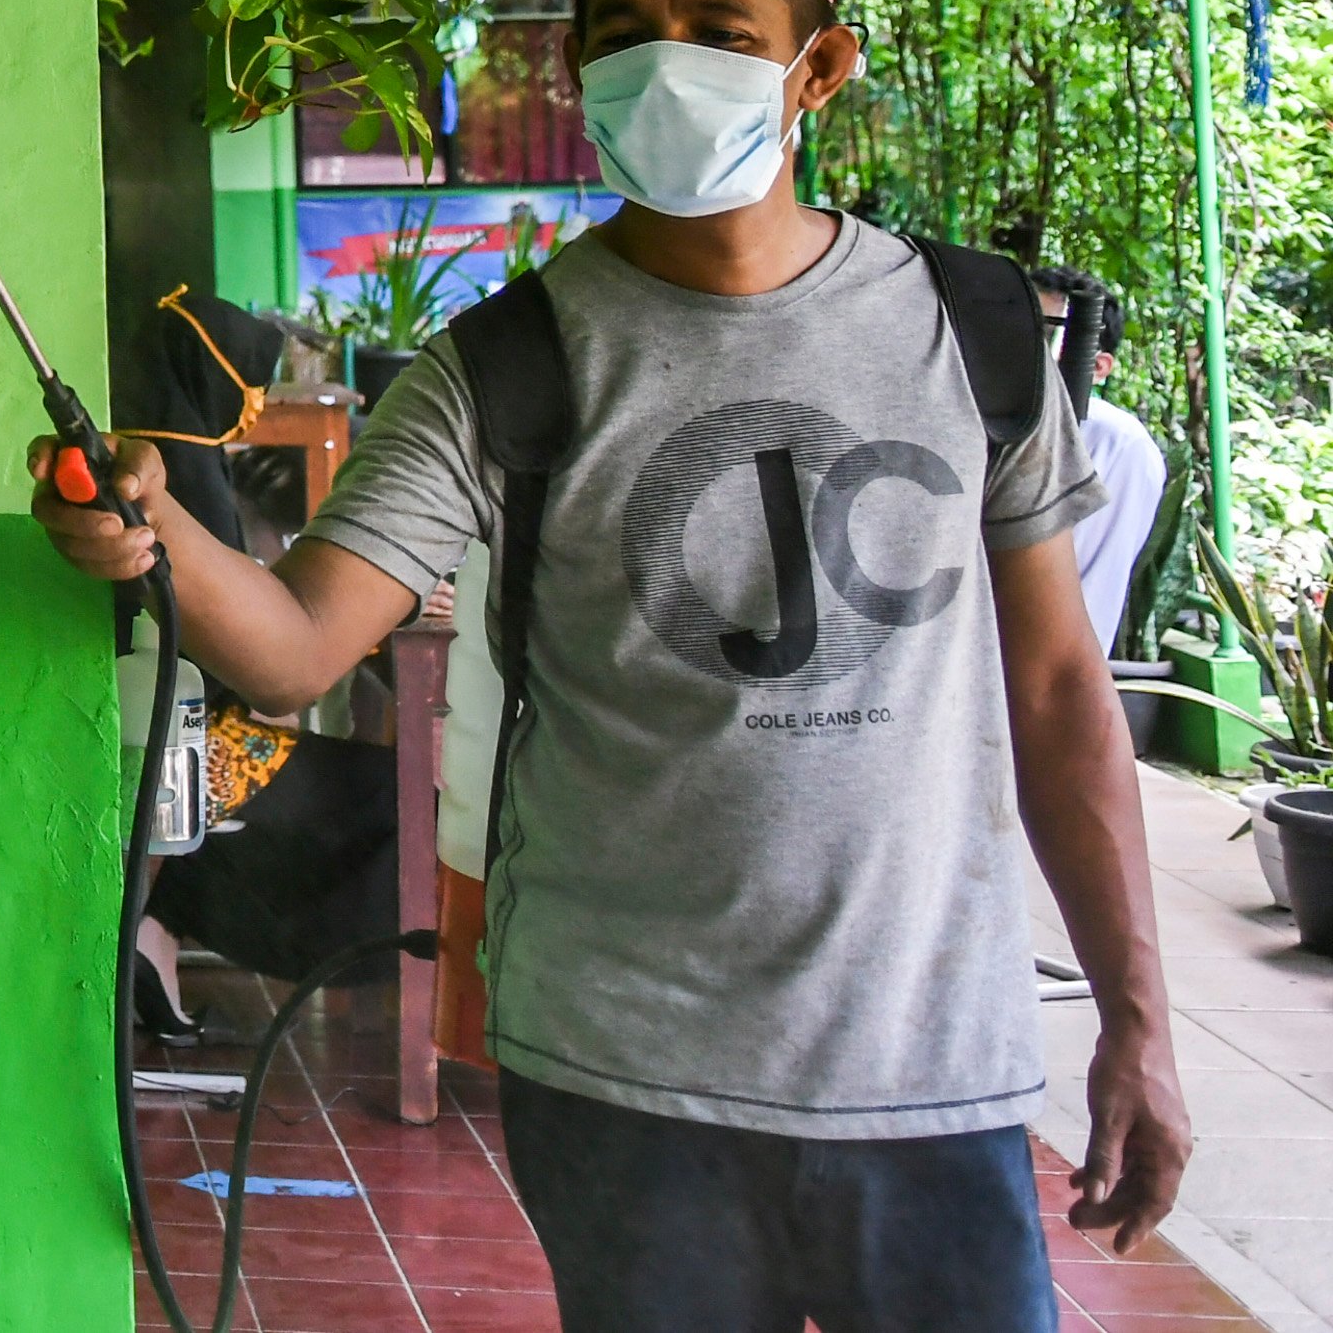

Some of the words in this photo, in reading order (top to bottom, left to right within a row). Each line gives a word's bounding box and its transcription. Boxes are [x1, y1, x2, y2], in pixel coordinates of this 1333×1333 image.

[745, 714, 797, 729] COLE
[803, 710, 862, 727] JEANS
[867, 708, 895, 723] CO.
